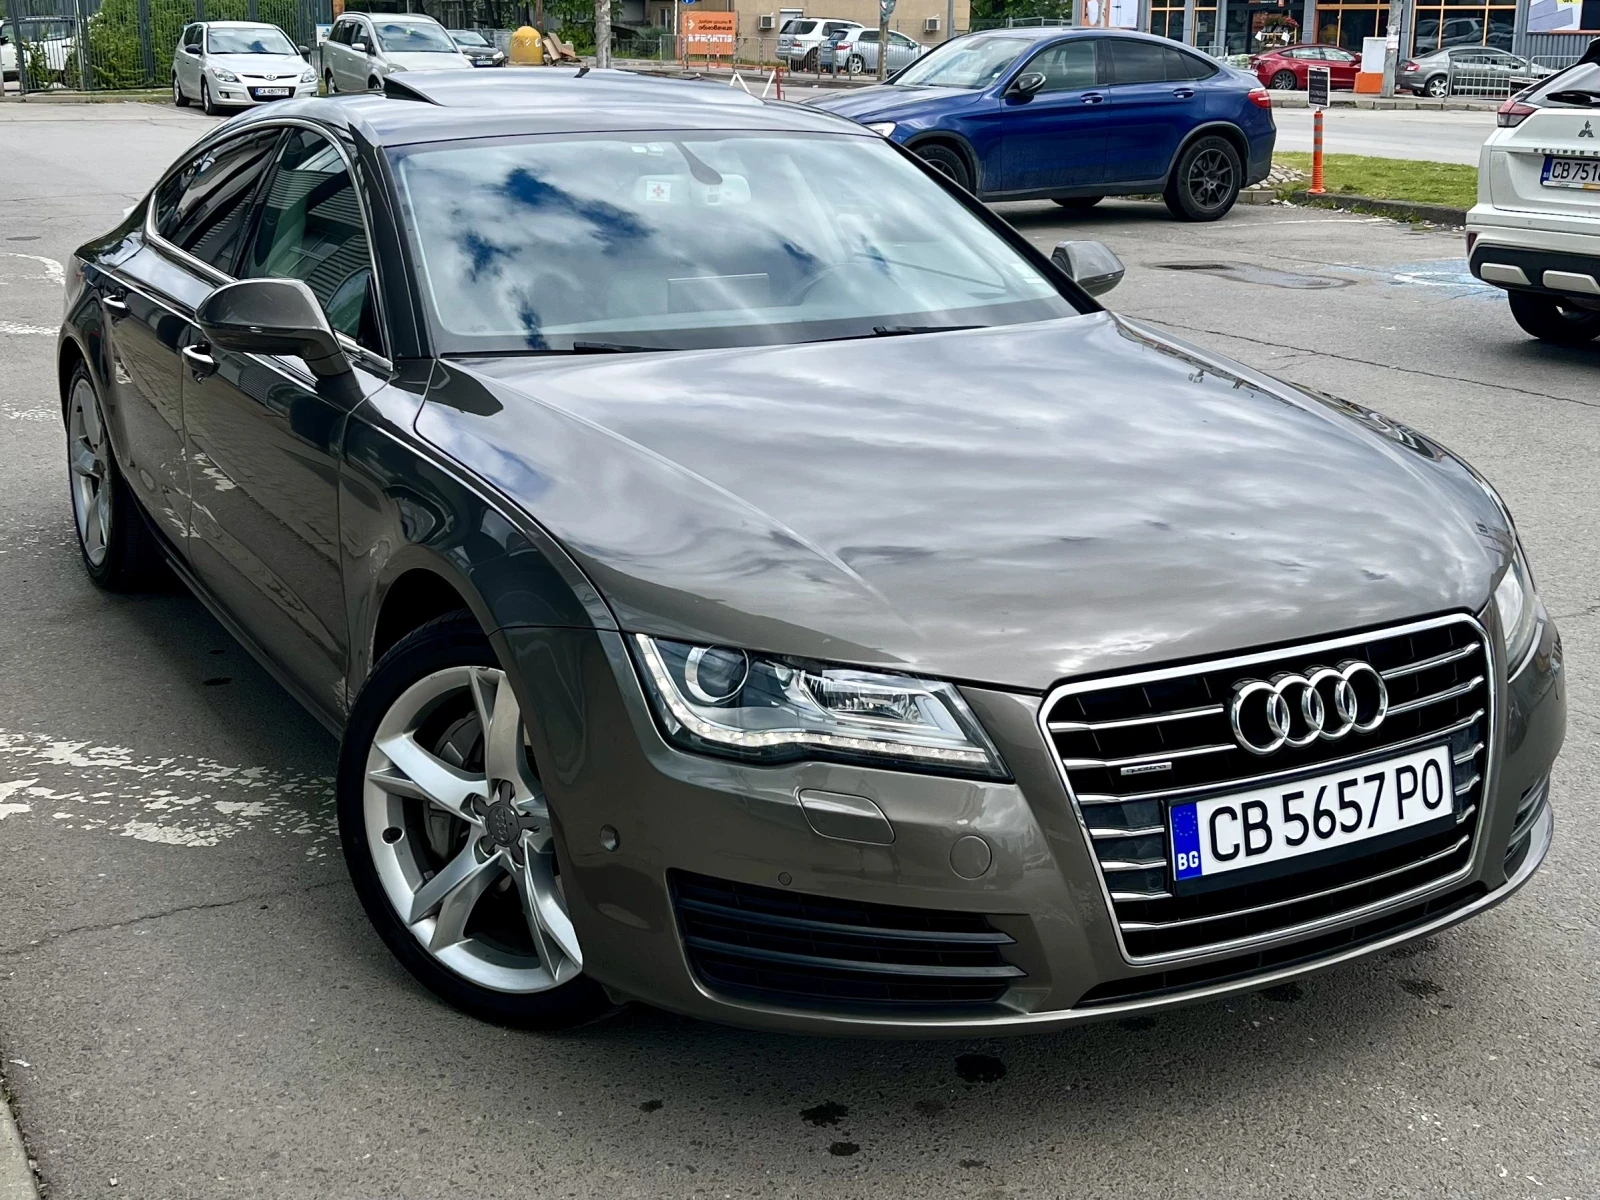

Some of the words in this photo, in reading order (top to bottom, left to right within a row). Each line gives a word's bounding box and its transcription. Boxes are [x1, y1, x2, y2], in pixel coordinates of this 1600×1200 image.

[1552, 161, 1571, 179] CB
[1571, 163, 1600, 182] 751
[1209, 800, 1273, 863] CB
[1282, 771, 1386, 847] 5657
[1396, 758, 1444, 820] PO
[1177, 851, 1200, 871] BG
